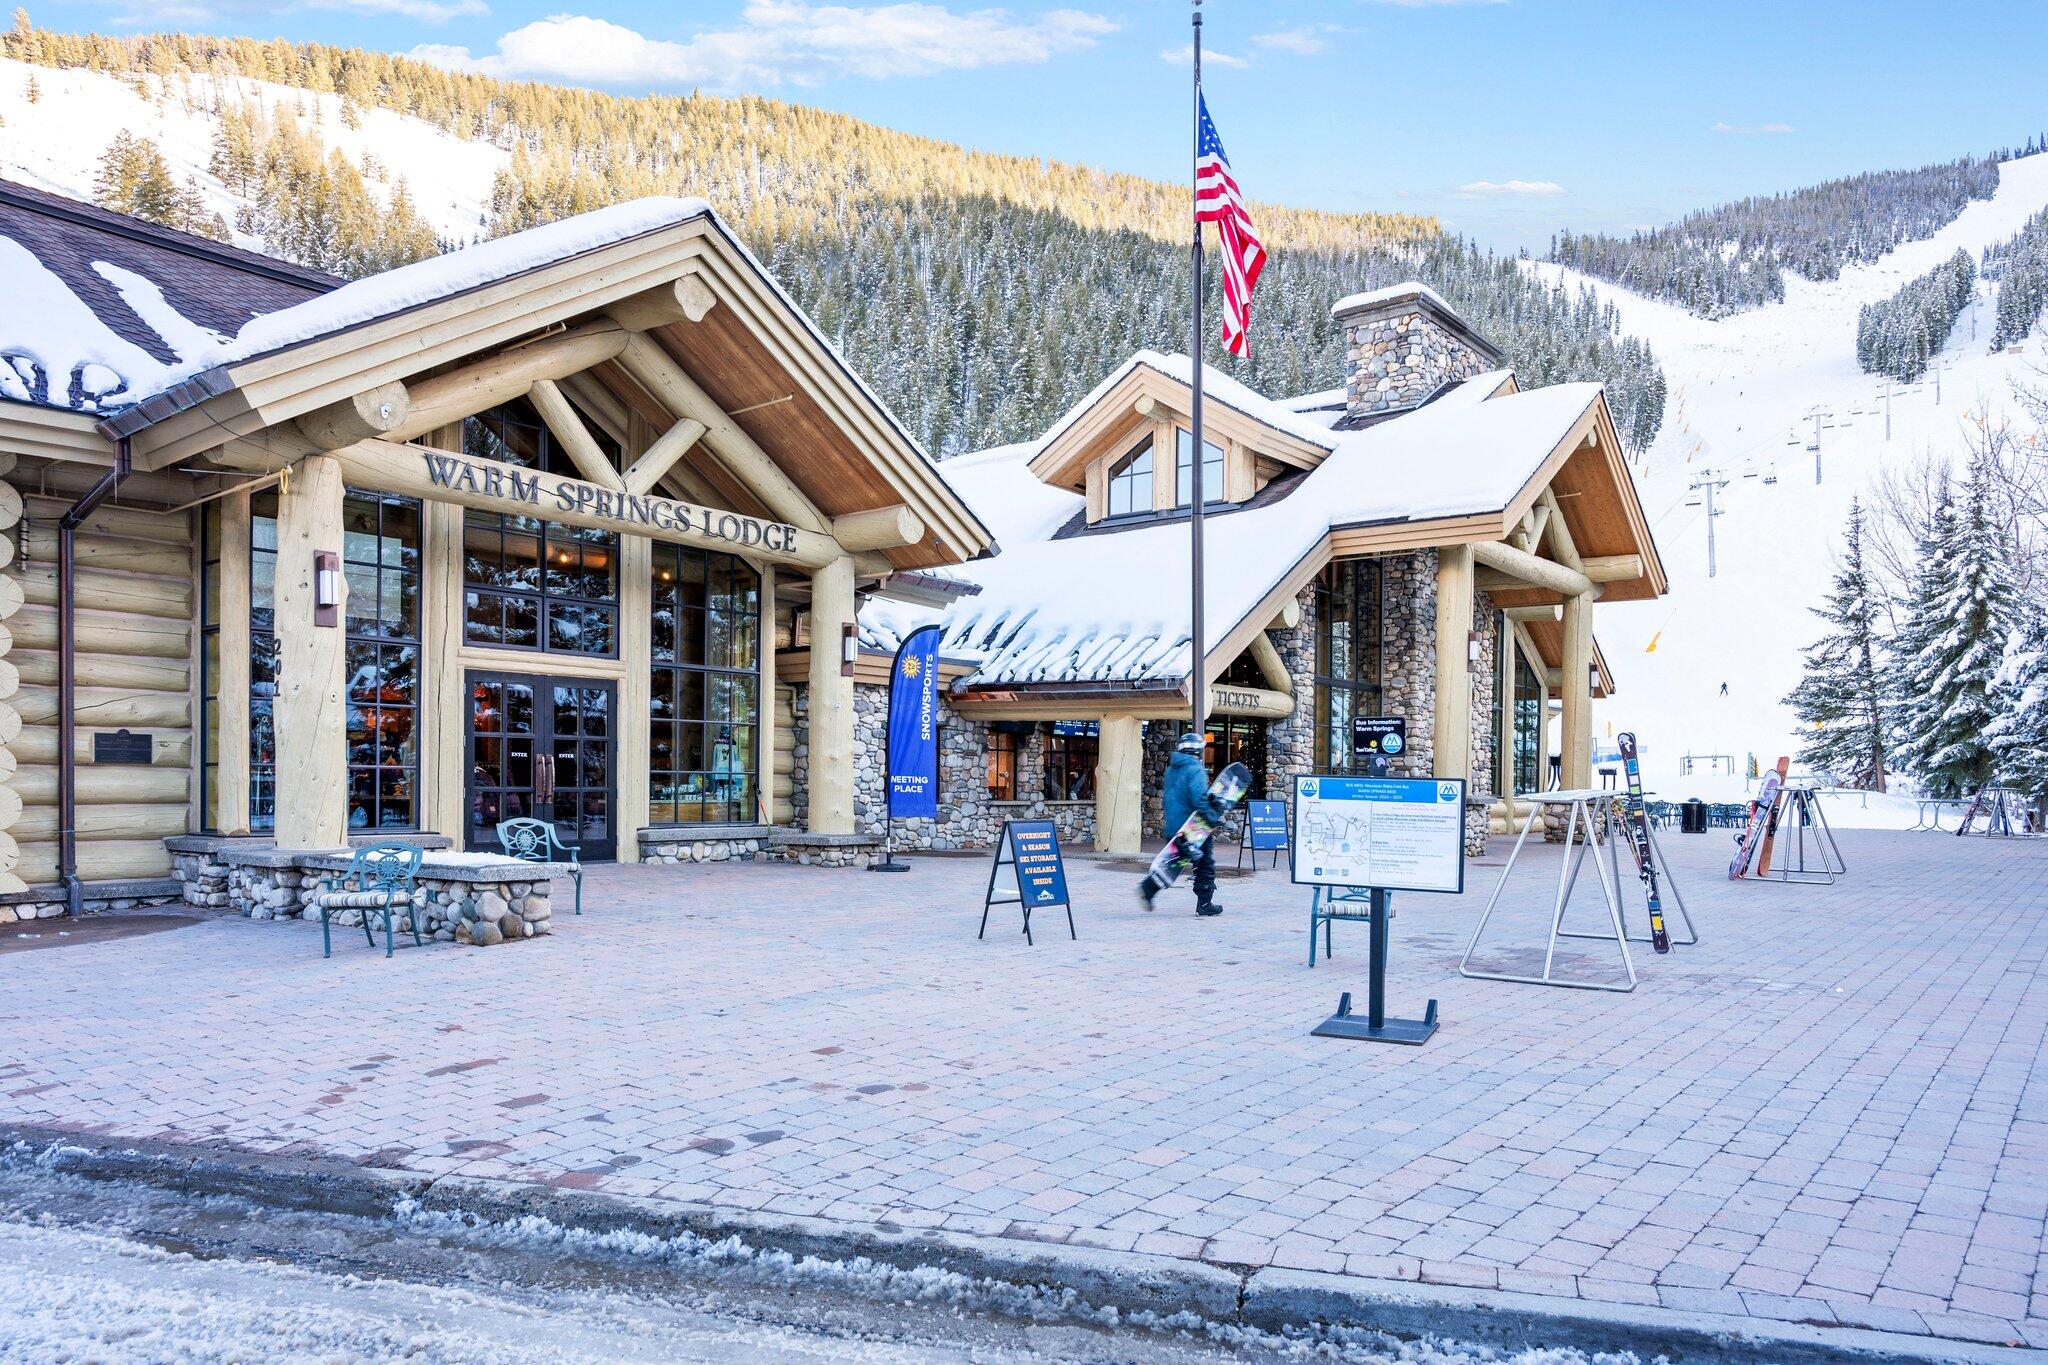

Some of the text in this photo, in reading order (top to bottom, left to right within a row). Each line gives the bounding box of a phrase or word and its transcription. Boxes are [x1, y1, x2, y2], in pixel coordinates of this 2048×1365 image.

[424, 451, 798, 553] WARM SPRINGS LODGE
[273, 637, 282, 697] 201
[921, 653, 934, 742] SNOWSPORTS
[1216, 690, 1260, 709] TICKETS
[890, 775, 928, 784] MEETING
[894, 784, 923, 793] PLACE
[1019, 854, 1057, 863] SKI STORAGE
[1025, 865, 1057, 874] AVAILABLE
[1032, 877, 1053, 885] INSIDE
